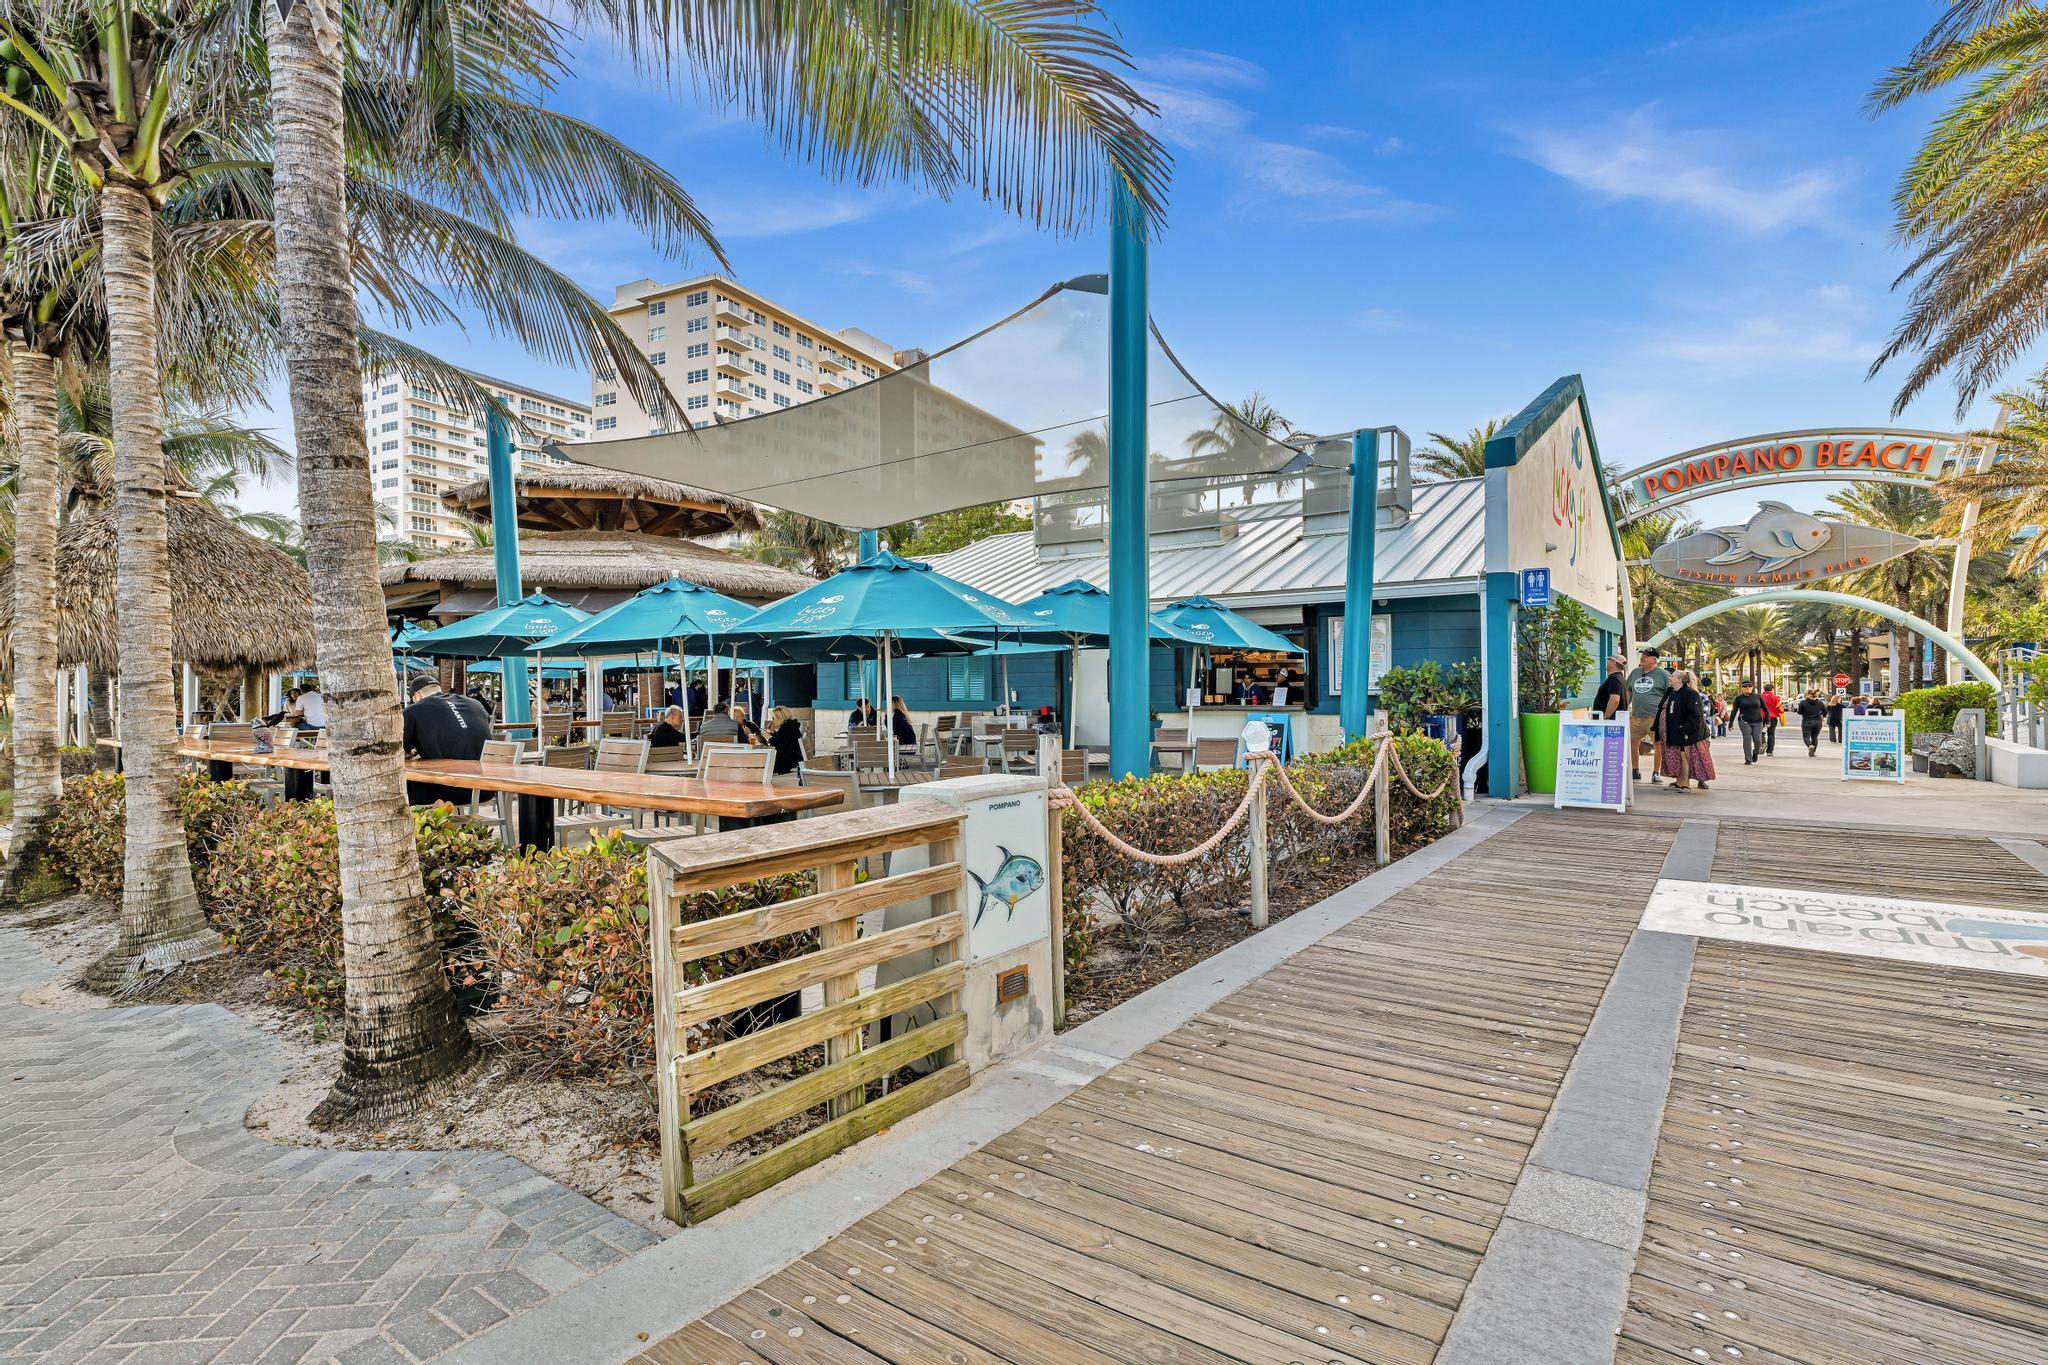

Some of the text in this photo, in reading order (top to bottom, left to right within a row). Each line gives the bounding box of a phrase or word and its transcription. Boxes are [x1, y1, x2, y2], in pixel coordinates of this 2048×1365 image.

[1642, 441, 1933, 499] POMPANO BEACH
[1679, 554, 1870, 584] FISHER FAMILY PIER
[1566, 757, 1601, 767] TWILIGHT
[1571, 748, 1589, 758] TIKI
[989, 800, 1021, 811] POMPANO
[1708, 889, 1825, 905] Welcome
[1707, 894, 1944, 932] beach
[1704, 911, 2048, 966] mpano
